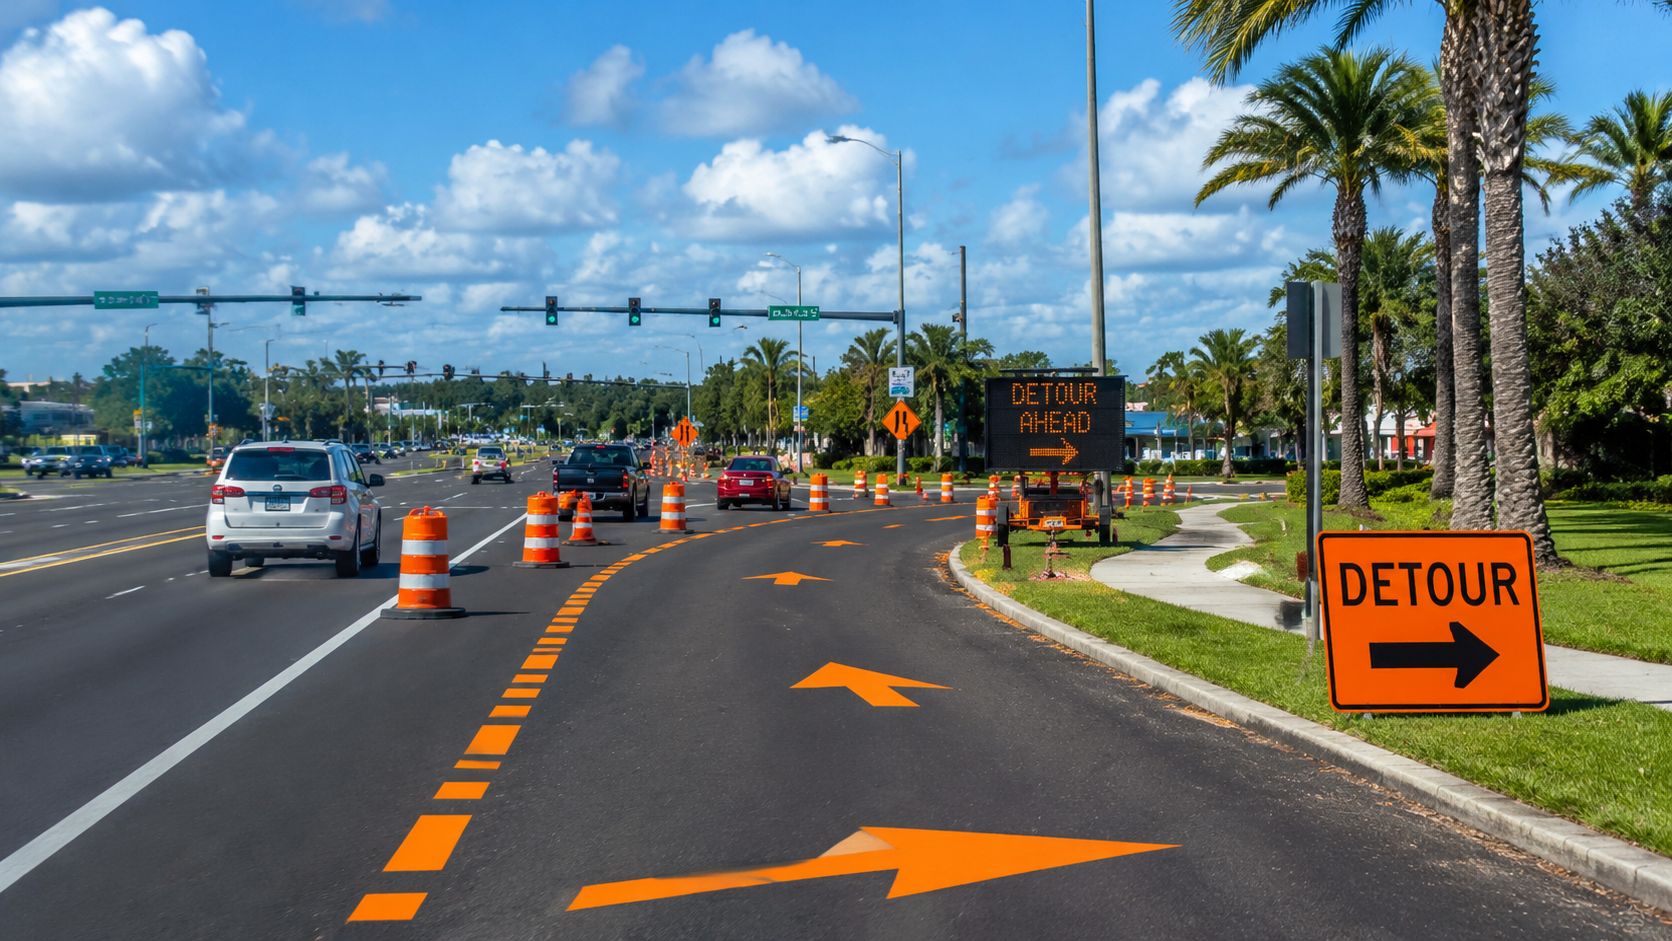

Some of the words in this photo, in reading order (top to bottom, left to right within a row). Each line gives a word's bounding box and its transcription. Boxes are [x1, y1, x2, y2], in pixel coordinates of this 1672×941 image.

[1012, 382, 1097, 405] DETOUR
[1019, 411, 1091, 433] AHEAD
[1339, 562, 1520, 607] DETOUR
